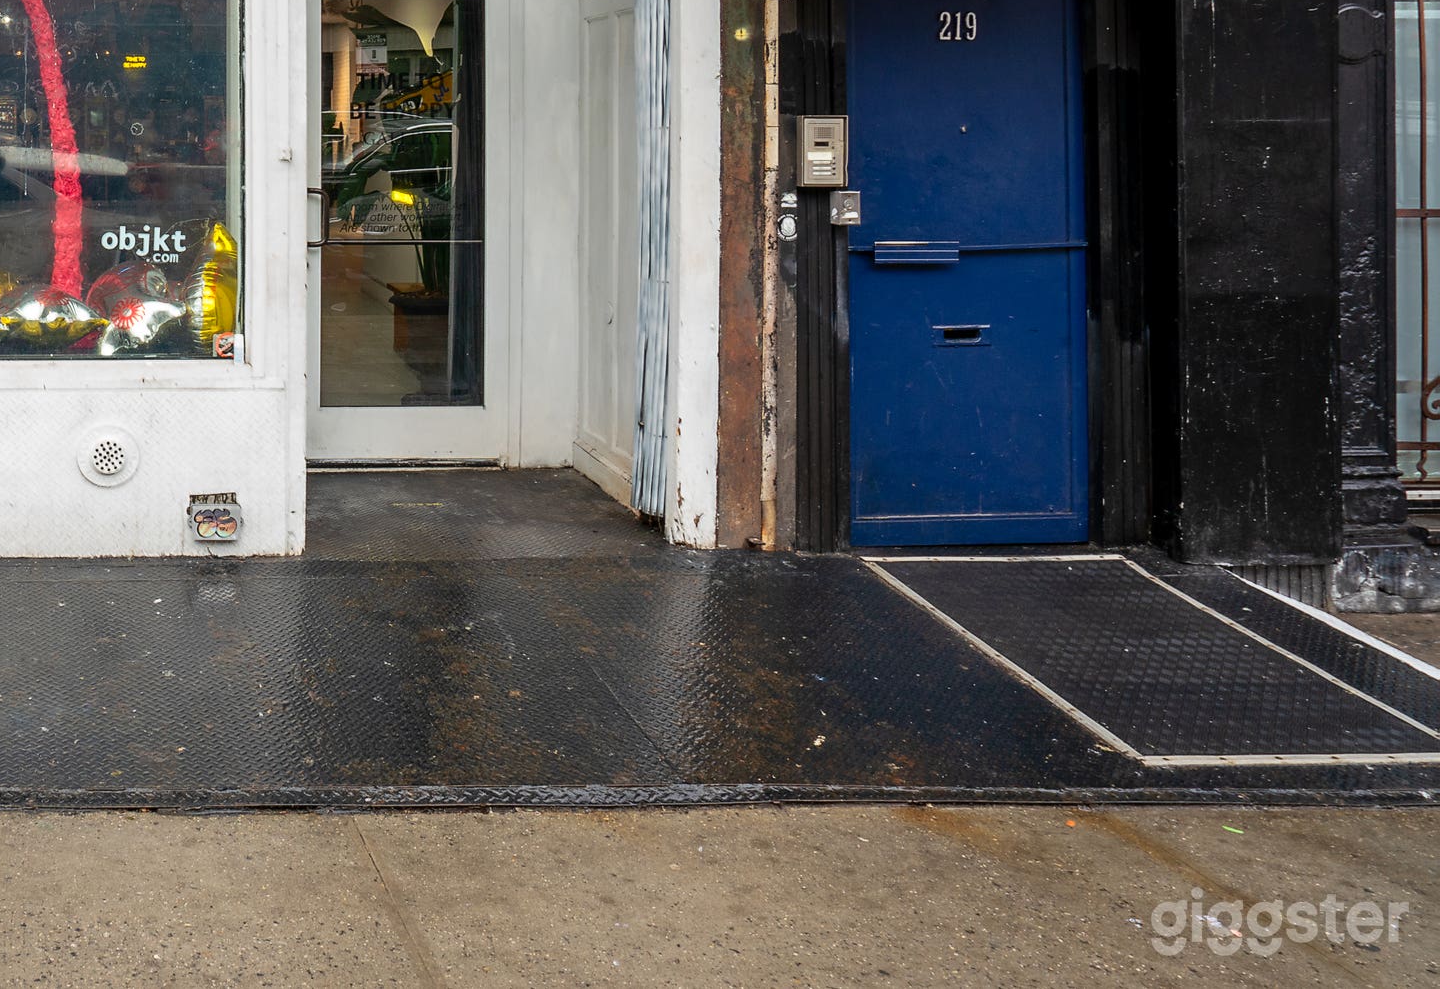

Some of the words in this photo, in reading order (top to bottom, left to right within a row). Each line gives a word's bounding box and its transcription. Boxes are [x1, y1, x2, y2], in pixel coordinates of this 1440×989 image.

[939, 11, 977, 41] 219
[370, 212, 397, 222] other
[340, 224, 358, 232] Are
[361, 223, 396, 233] shown
[101, 225, 187, 257] objkt
[146, 252, 179, 263] .com
